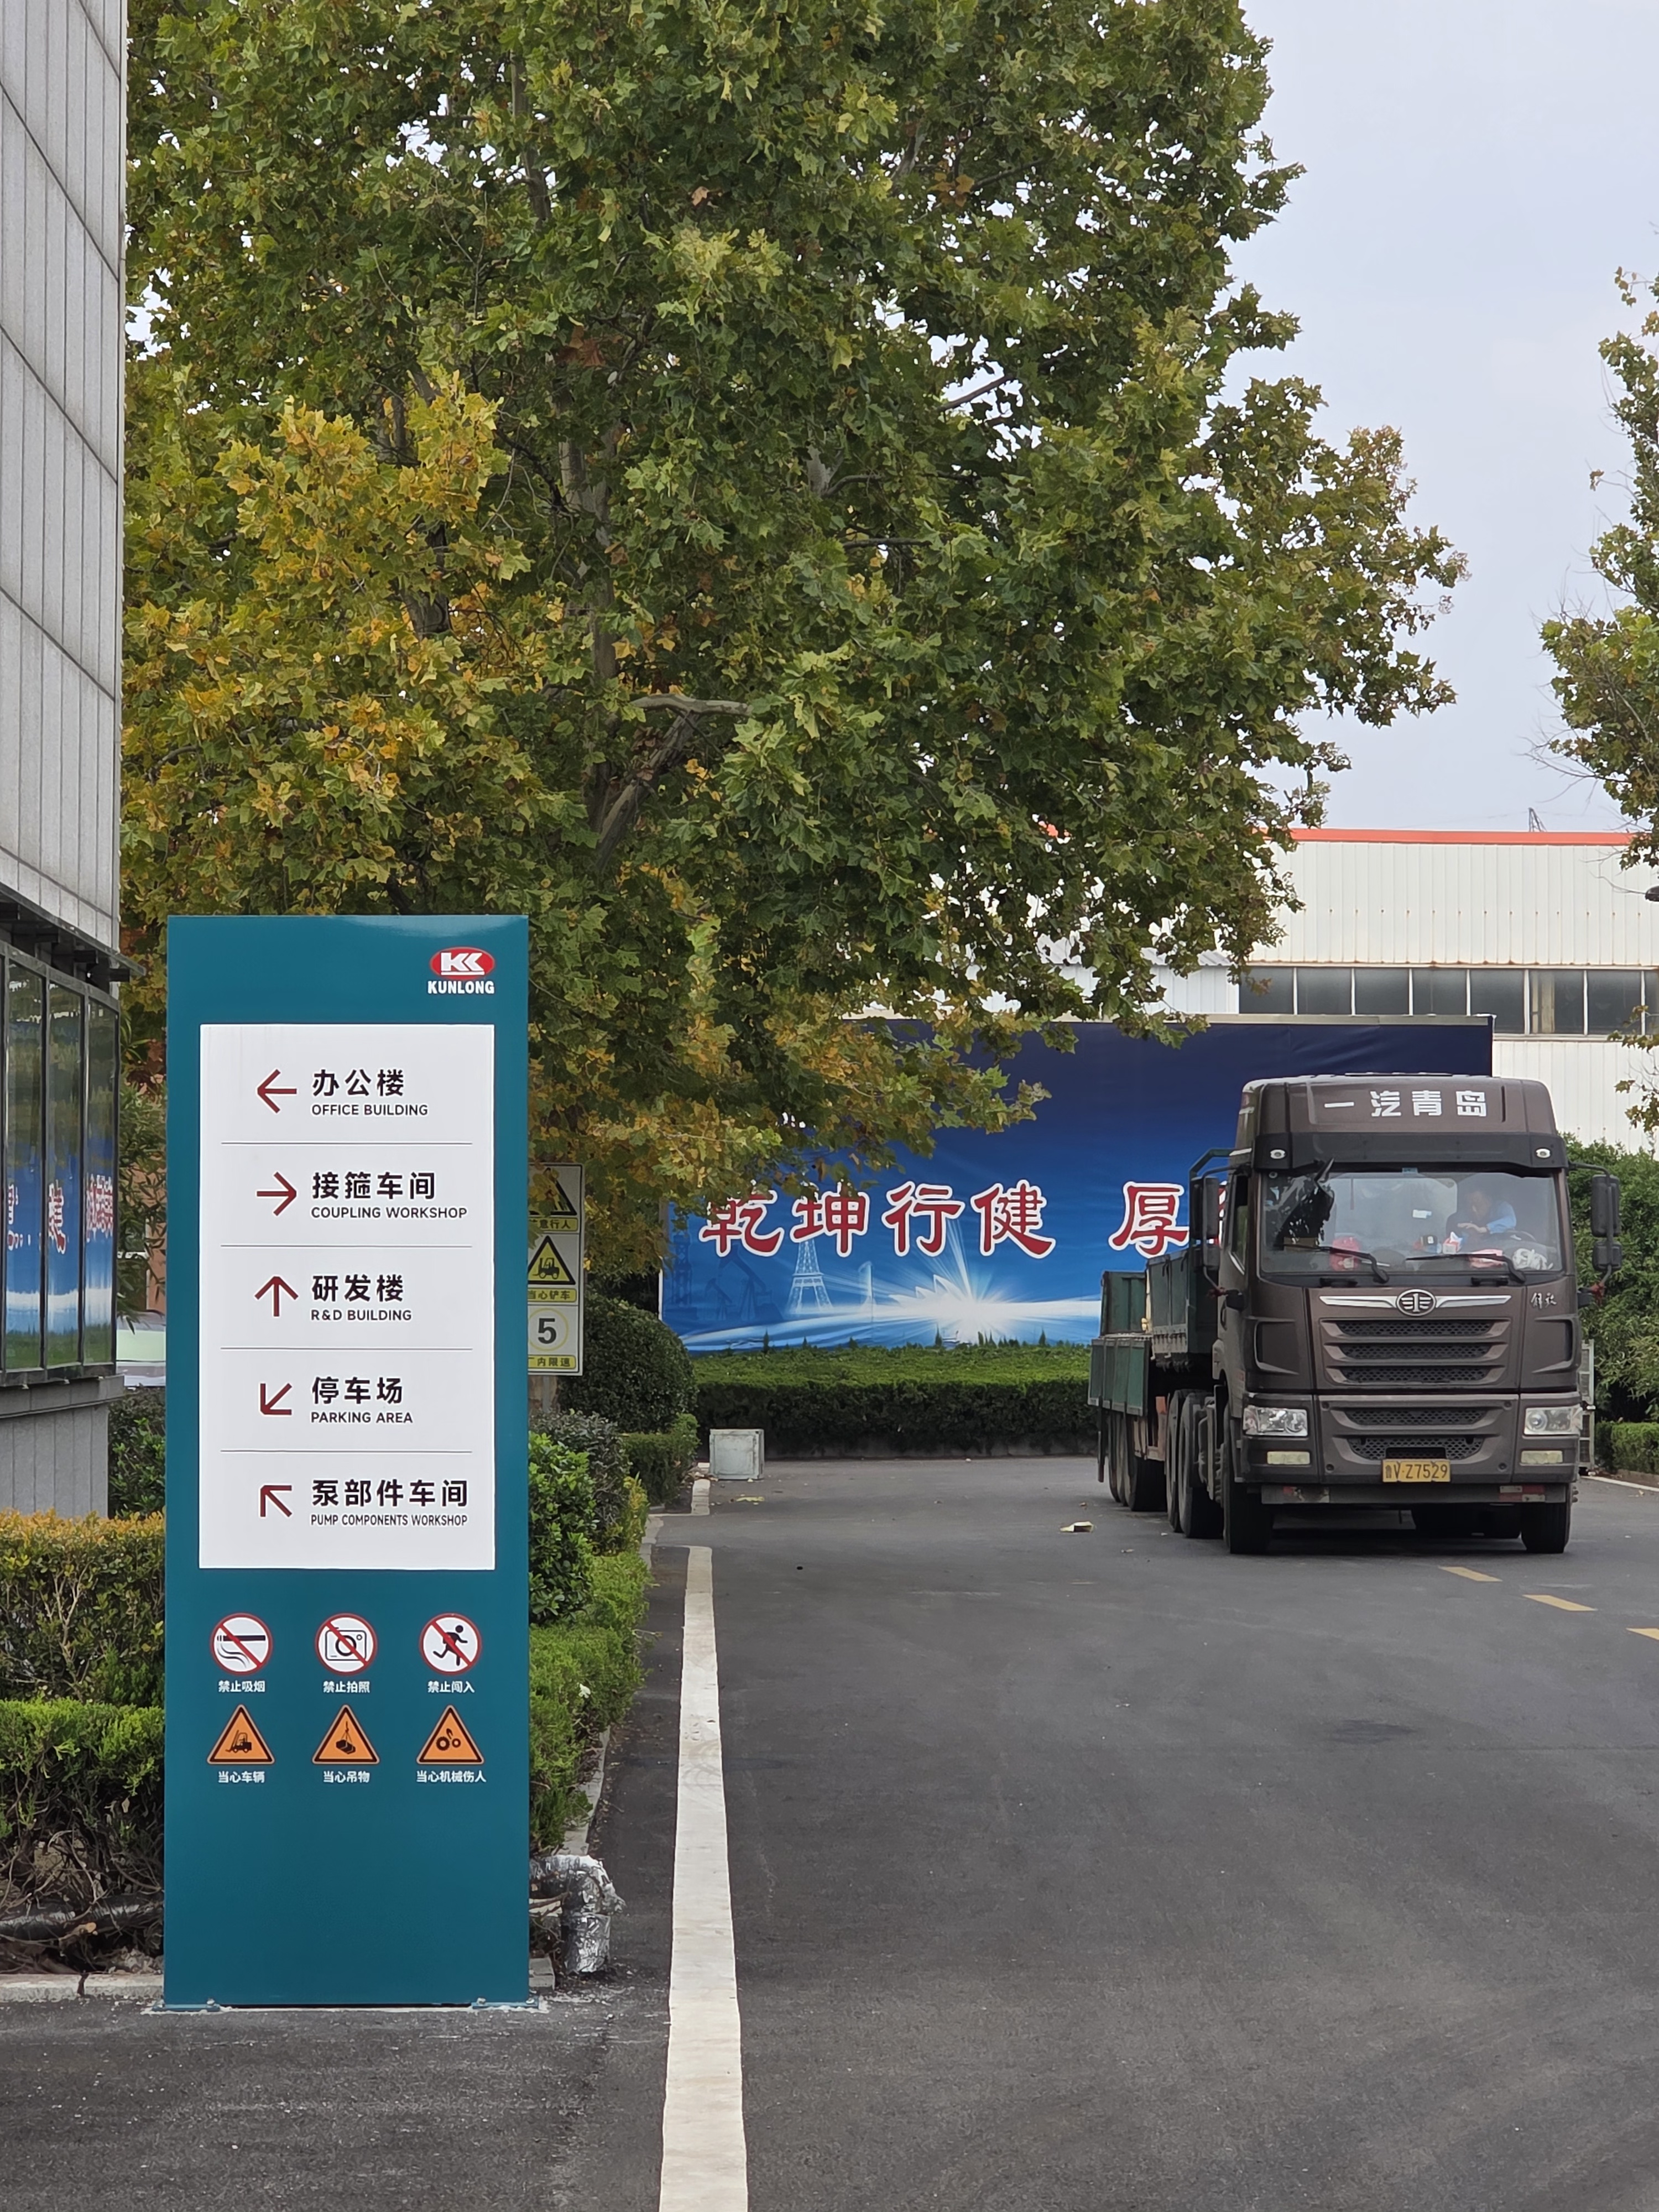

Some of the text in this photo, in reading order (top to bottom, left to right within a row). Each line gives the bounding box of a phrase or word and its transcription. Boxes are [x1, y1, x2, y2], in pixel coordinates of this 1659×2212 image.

[427, 980, 495, 994] KUNLONG
[312, 1069, 404, 1097] 办公楼
[312, 1104, 427, 1115] OFFICE BUILDING
[1324, 1090, 1487, 1117] 一汽青岛
[312, 1171, 435, 1199] 接箍车间
[311, 1207, 467, 1218] COUPLING WORKSHOP
[529, 1219, 571, 1229] 意行人
[700, 1180, 1056, 1259] 乾坤行健
[312, 1274, 403, 1302] 研发楼
[311, 1310, 411, 1321] R&D BUILDING
[538, 1318, 556, 1344] 5
[312, 1376, 402, 1405] 停车场
[311, 1412, 413, 1423] PARKING AREA
[312, 1479, 467, 1507] 泵部件车间
[311, 1514, 467, 1526] PUMP COMPONENTS WORKSHOP
[218, 1680, 265, 1693] 禁止吸烟
[323, 1681, 371, 1693] 禁止拍照
[427, 1681, 475, 1694] 禁止闯入
[218, 1770, 265, 1783] 当心车辆
[323, 1770, 371, 1783] 当心吊物
[416, 1770, 487, 1783] 当心机械伤人
